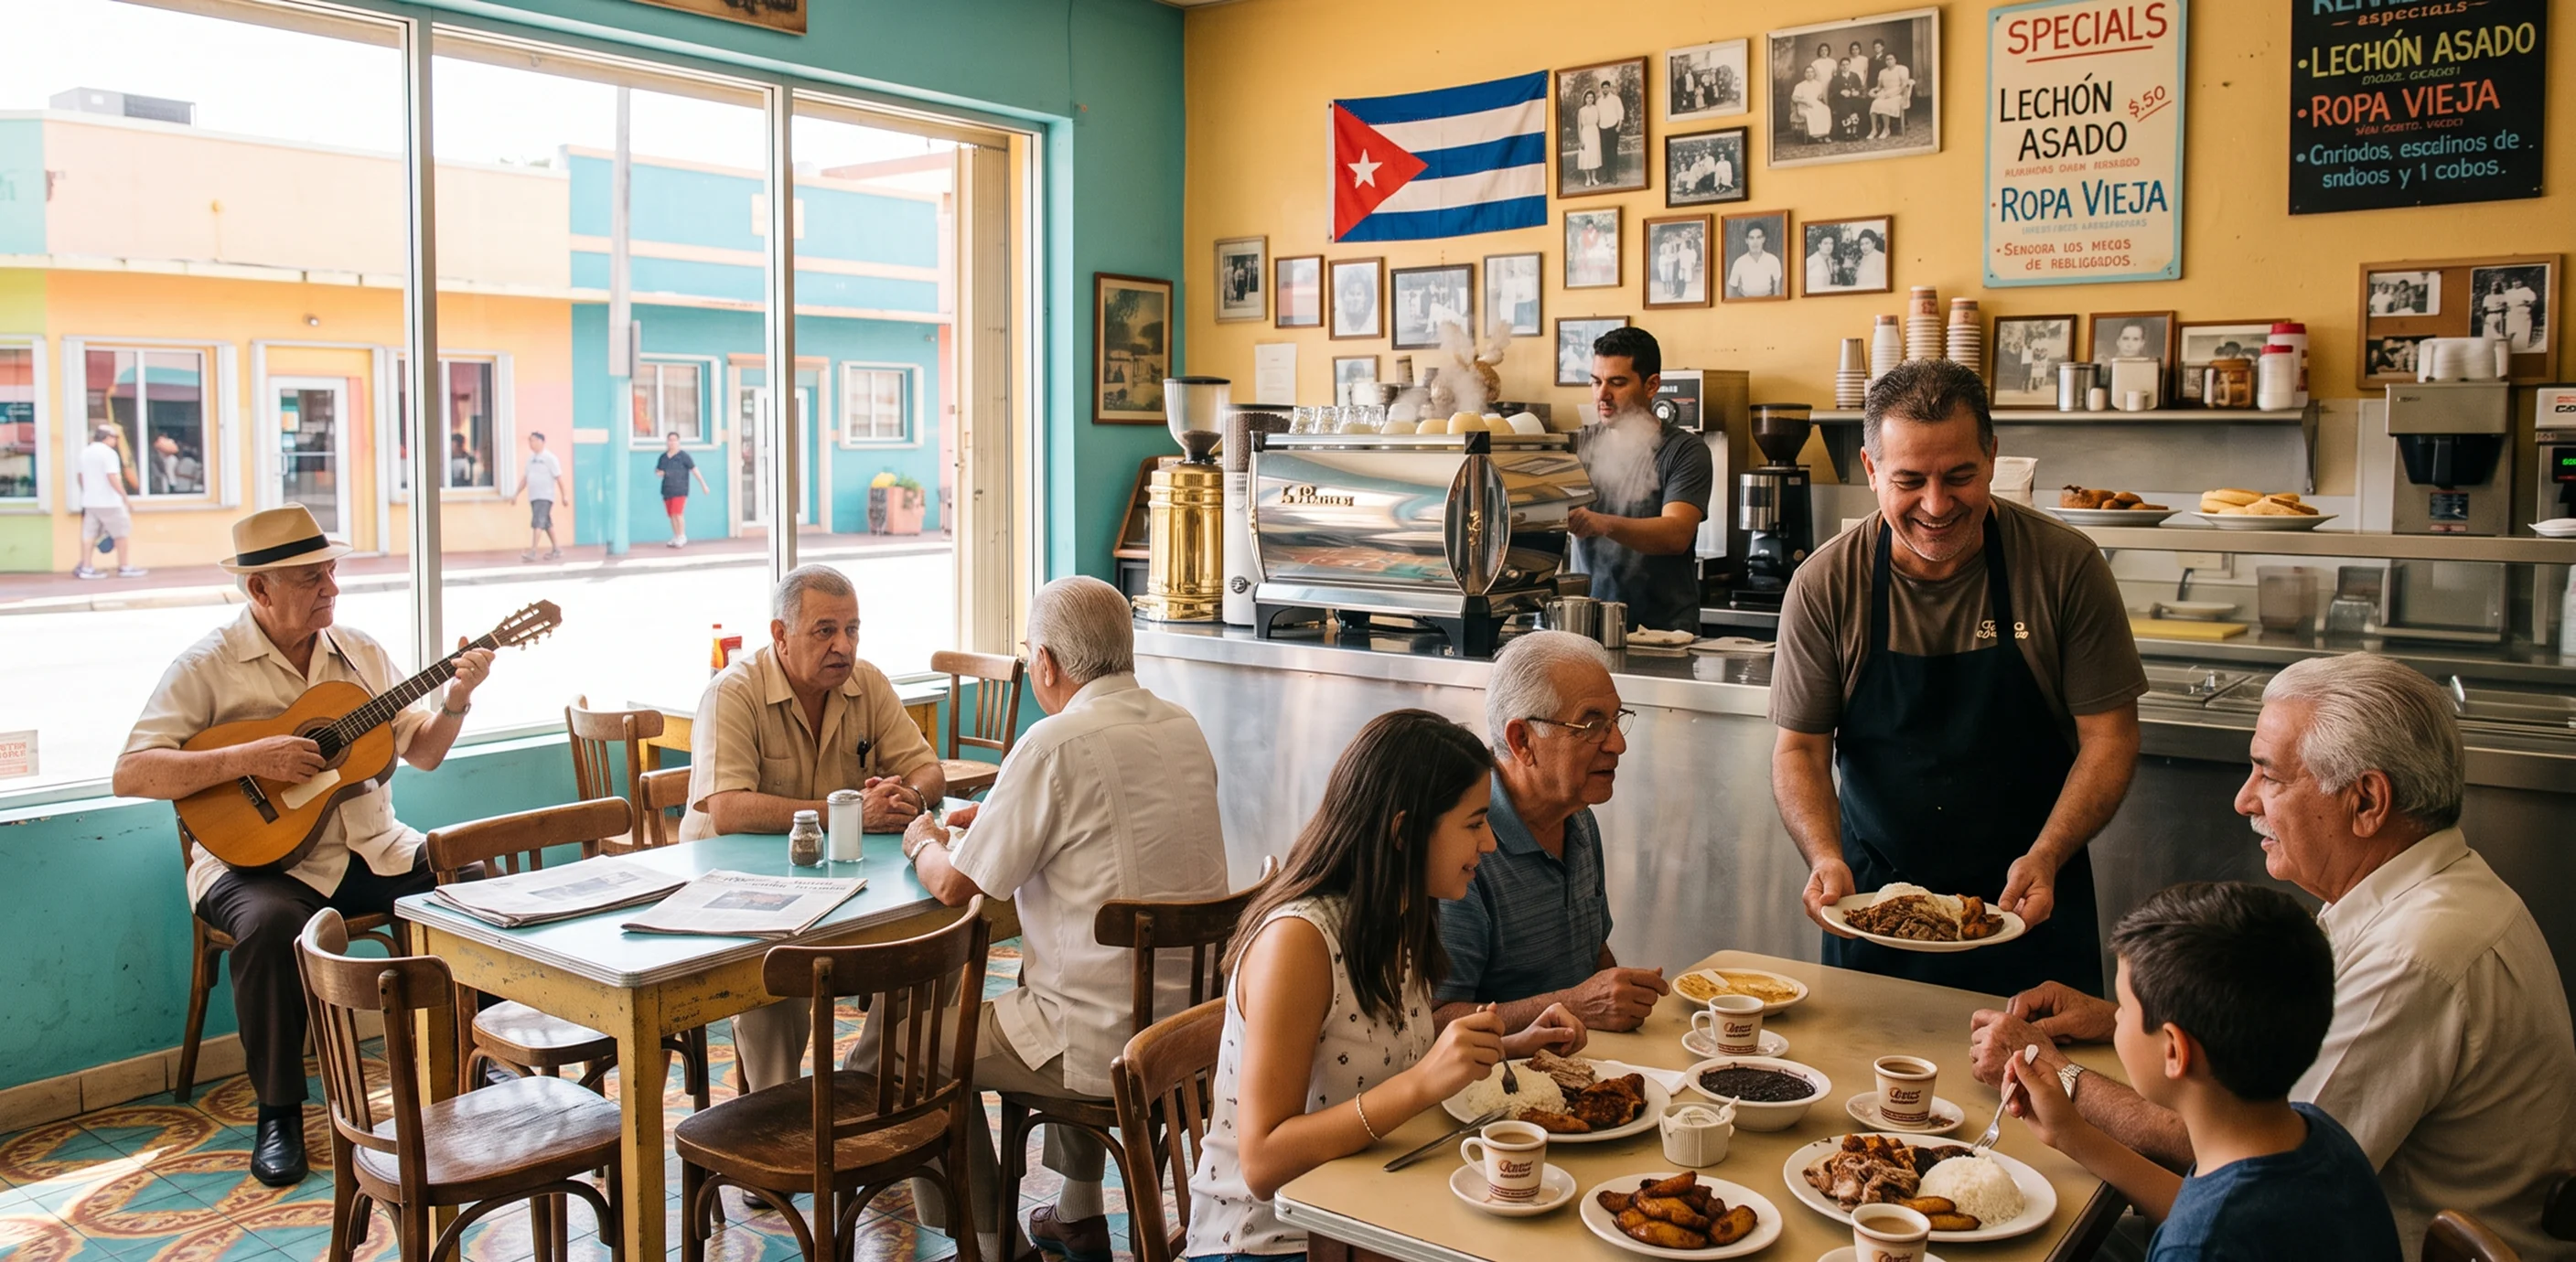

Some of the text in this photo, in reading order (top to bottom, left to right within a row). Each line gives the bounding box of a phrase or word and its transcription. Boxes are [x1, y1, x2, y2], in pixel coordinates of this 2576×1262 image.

[2008, 2, 2168, 54] SPECIALS
[2312, 29, 2422, 78] LECHÓN
[2432, 22, 2536, 64] ASADO
[2000, 72, 2112, 123] LECHÓN
[2128, 85, 2166, 118] $.50
[2312, 91, 2391, 128] ROPA
[2402, 79, 2501, 119] VIEJA
[2018, 121, 2127, 161] ASADO
[2494, 129, 2520, 150] de
[2398, 167, 2412, 189] y
[2001, 179, 2168, 222] ROPA VIEJA
[2064, 242, 2083, 252] LOS
